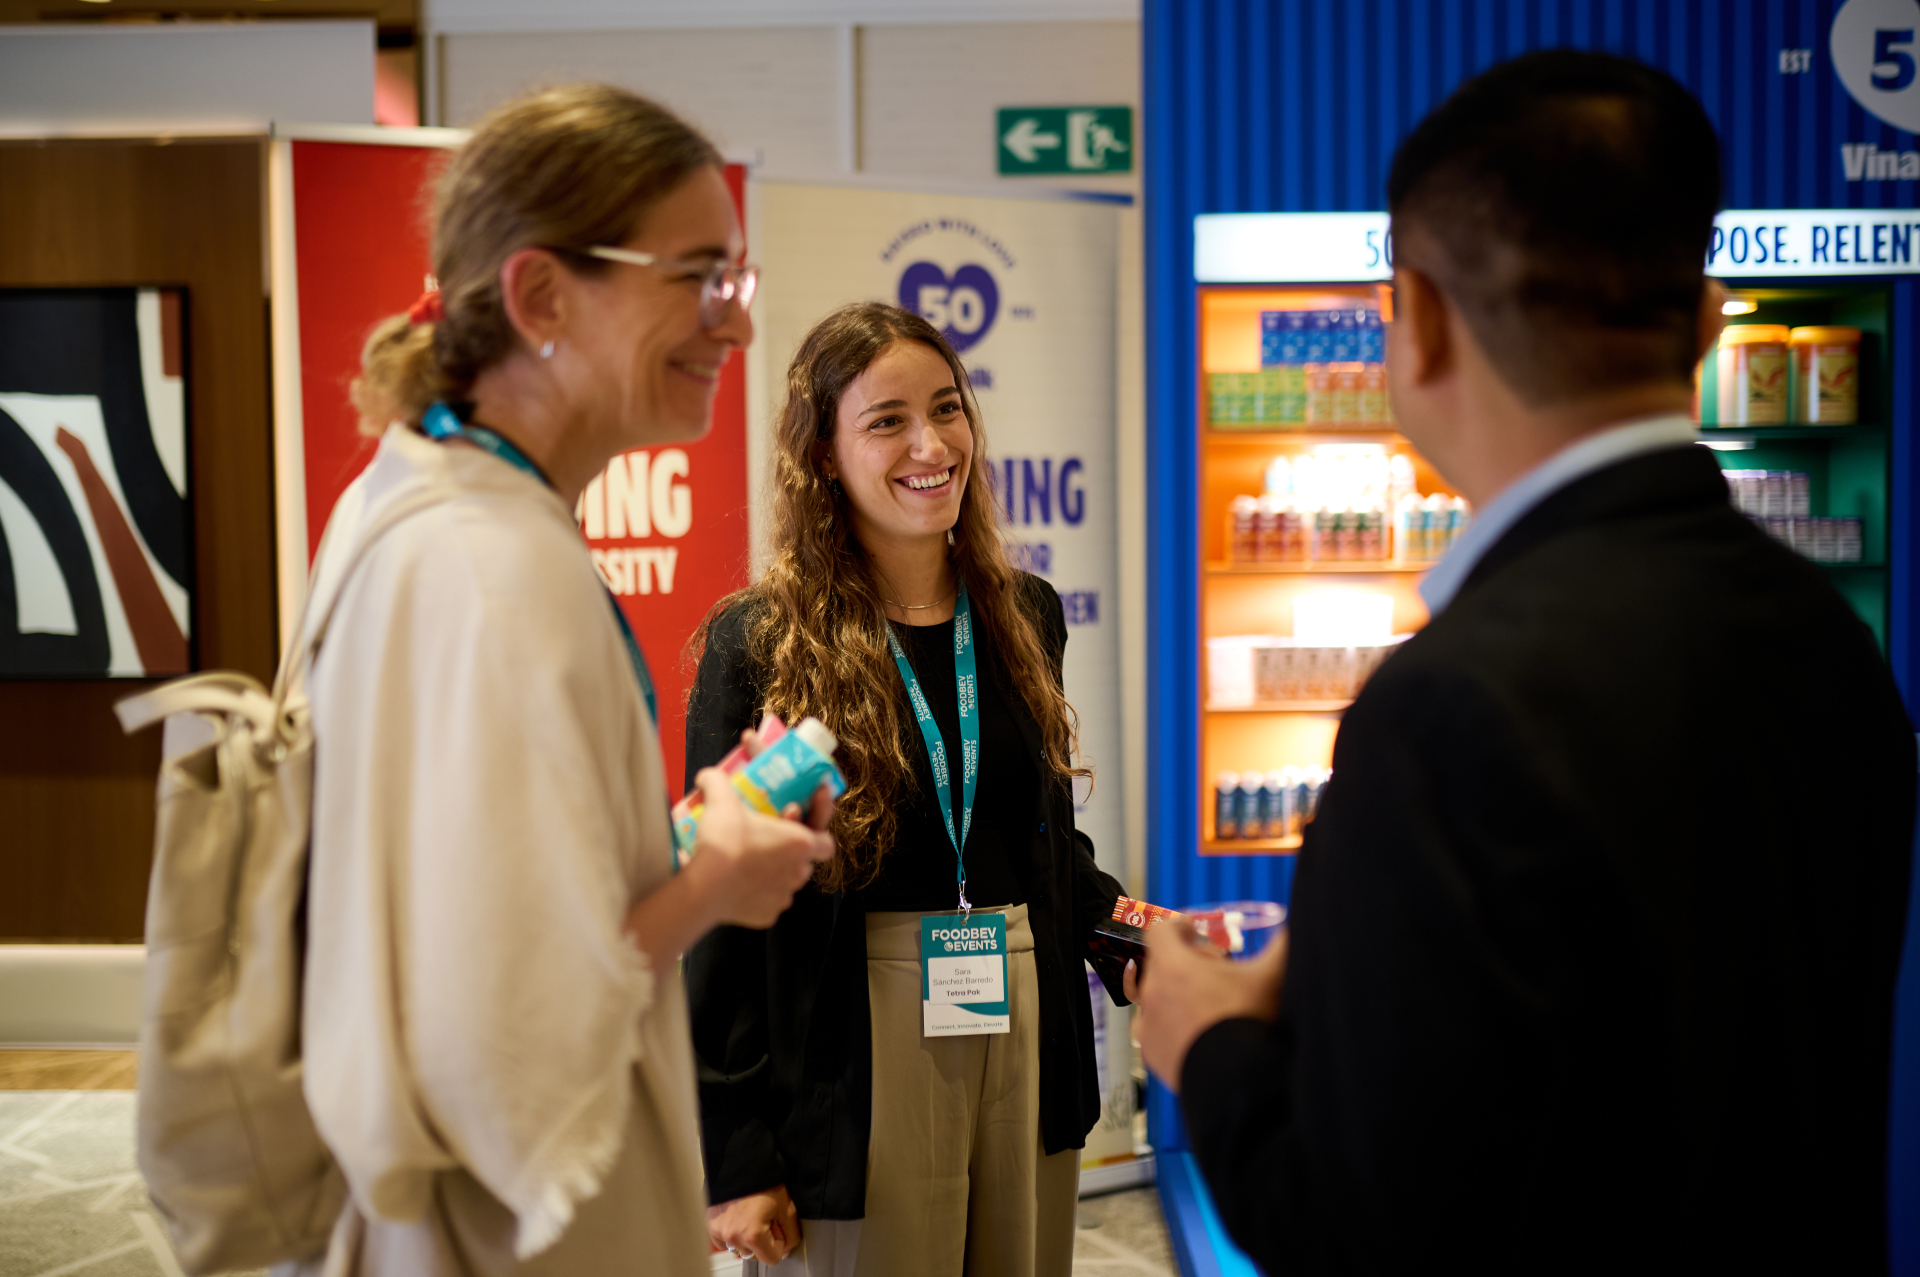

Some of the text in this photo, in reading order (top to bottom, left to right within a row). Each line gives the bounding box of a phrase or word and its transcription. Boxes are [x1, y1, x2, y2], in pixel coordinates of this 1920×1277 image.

[1779, 49, 1812, 74] EST
[918, 284, 986, 335] 50
[574, 448, 692, 539] ING
[955, 615, 964, 654] FOODBEV
[962, 611, 971, 640] EVENTS
[910, 678, 931, 720] FOODBEV
[957, 675, 968, 717] FOODBEV
[966, 674, 974, 704] EVENTS
[911, 692, 925, 722] EVENTS
[932, 757, 943, 788] EVENTS
[934, 741, 948, 786] FOODBEV
[931, 927, 997, 941] FOODBEV
[954, 939, 997, 952] EVENTS
[954, 968, 971, 976] Sara
[965, 976, 994, 985] Barredo
